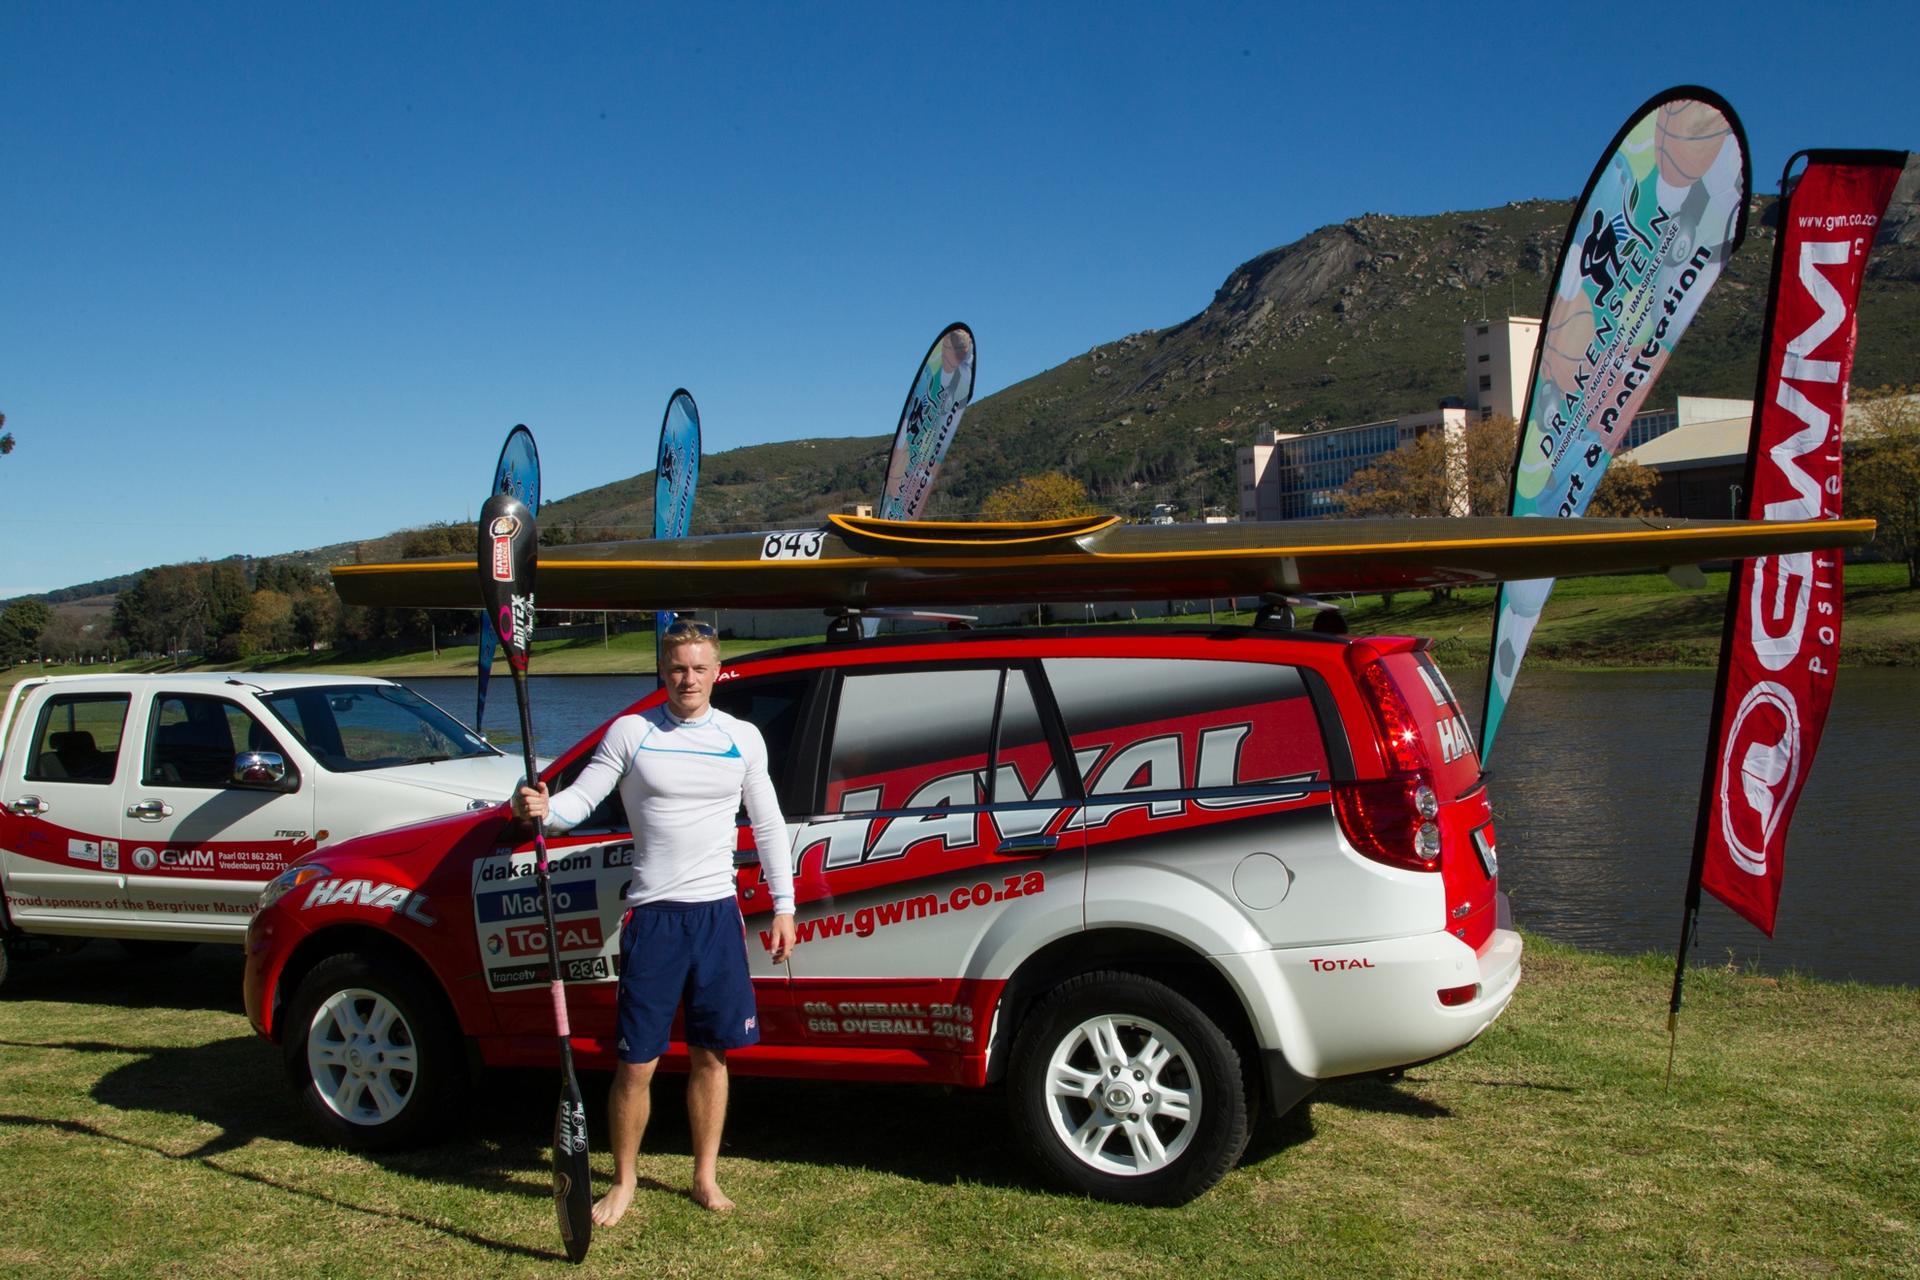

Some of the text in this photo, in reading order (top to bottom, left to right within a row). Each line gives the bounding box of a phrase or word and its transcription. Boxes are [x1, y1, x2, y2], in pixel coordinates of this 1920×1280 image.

[1539, 205, 1672, 460] DRAKENSTEIN
[1550, 222, 1679, 470] MUNISIPALITEIT MUNICIPALITY UMASIPALE WASE
[907, 400, 960, 517] Recreation
[1557, 471, 1584, 518] ort
[764, 531, 825, 558] 843
[758, 722, 1321, 883] HAVAL
[274, 829, 306, 838] STEED
[159, 849, 215, 866] GWM
[218, 852, 282, 861] Paarl 021 862 2941
[219, 861, 260, 872] Vredenburg
[261, 862, 275, 871] 022
[5, 895, 41, 907] Proud
[45, 897, 102, 909] sponsors
[104, 898, 119, 909] of
[121, 899, 144, 910] the
[147, 900, 209, 913] Bergriver
[300, 879, 437, 928] HAVAL
[510, 927, 600, 951] TOAL
[569, 958, 607, 979] 234
[1309, 957, 1375, 972] TOTAL
[838, 1002, 928, 1017] OVERALL
[929, 1003, 973, 1022] 2013
[842, 1019, 929, 1035] OVERALL
[933, 1022, 974, 1042] 2012
